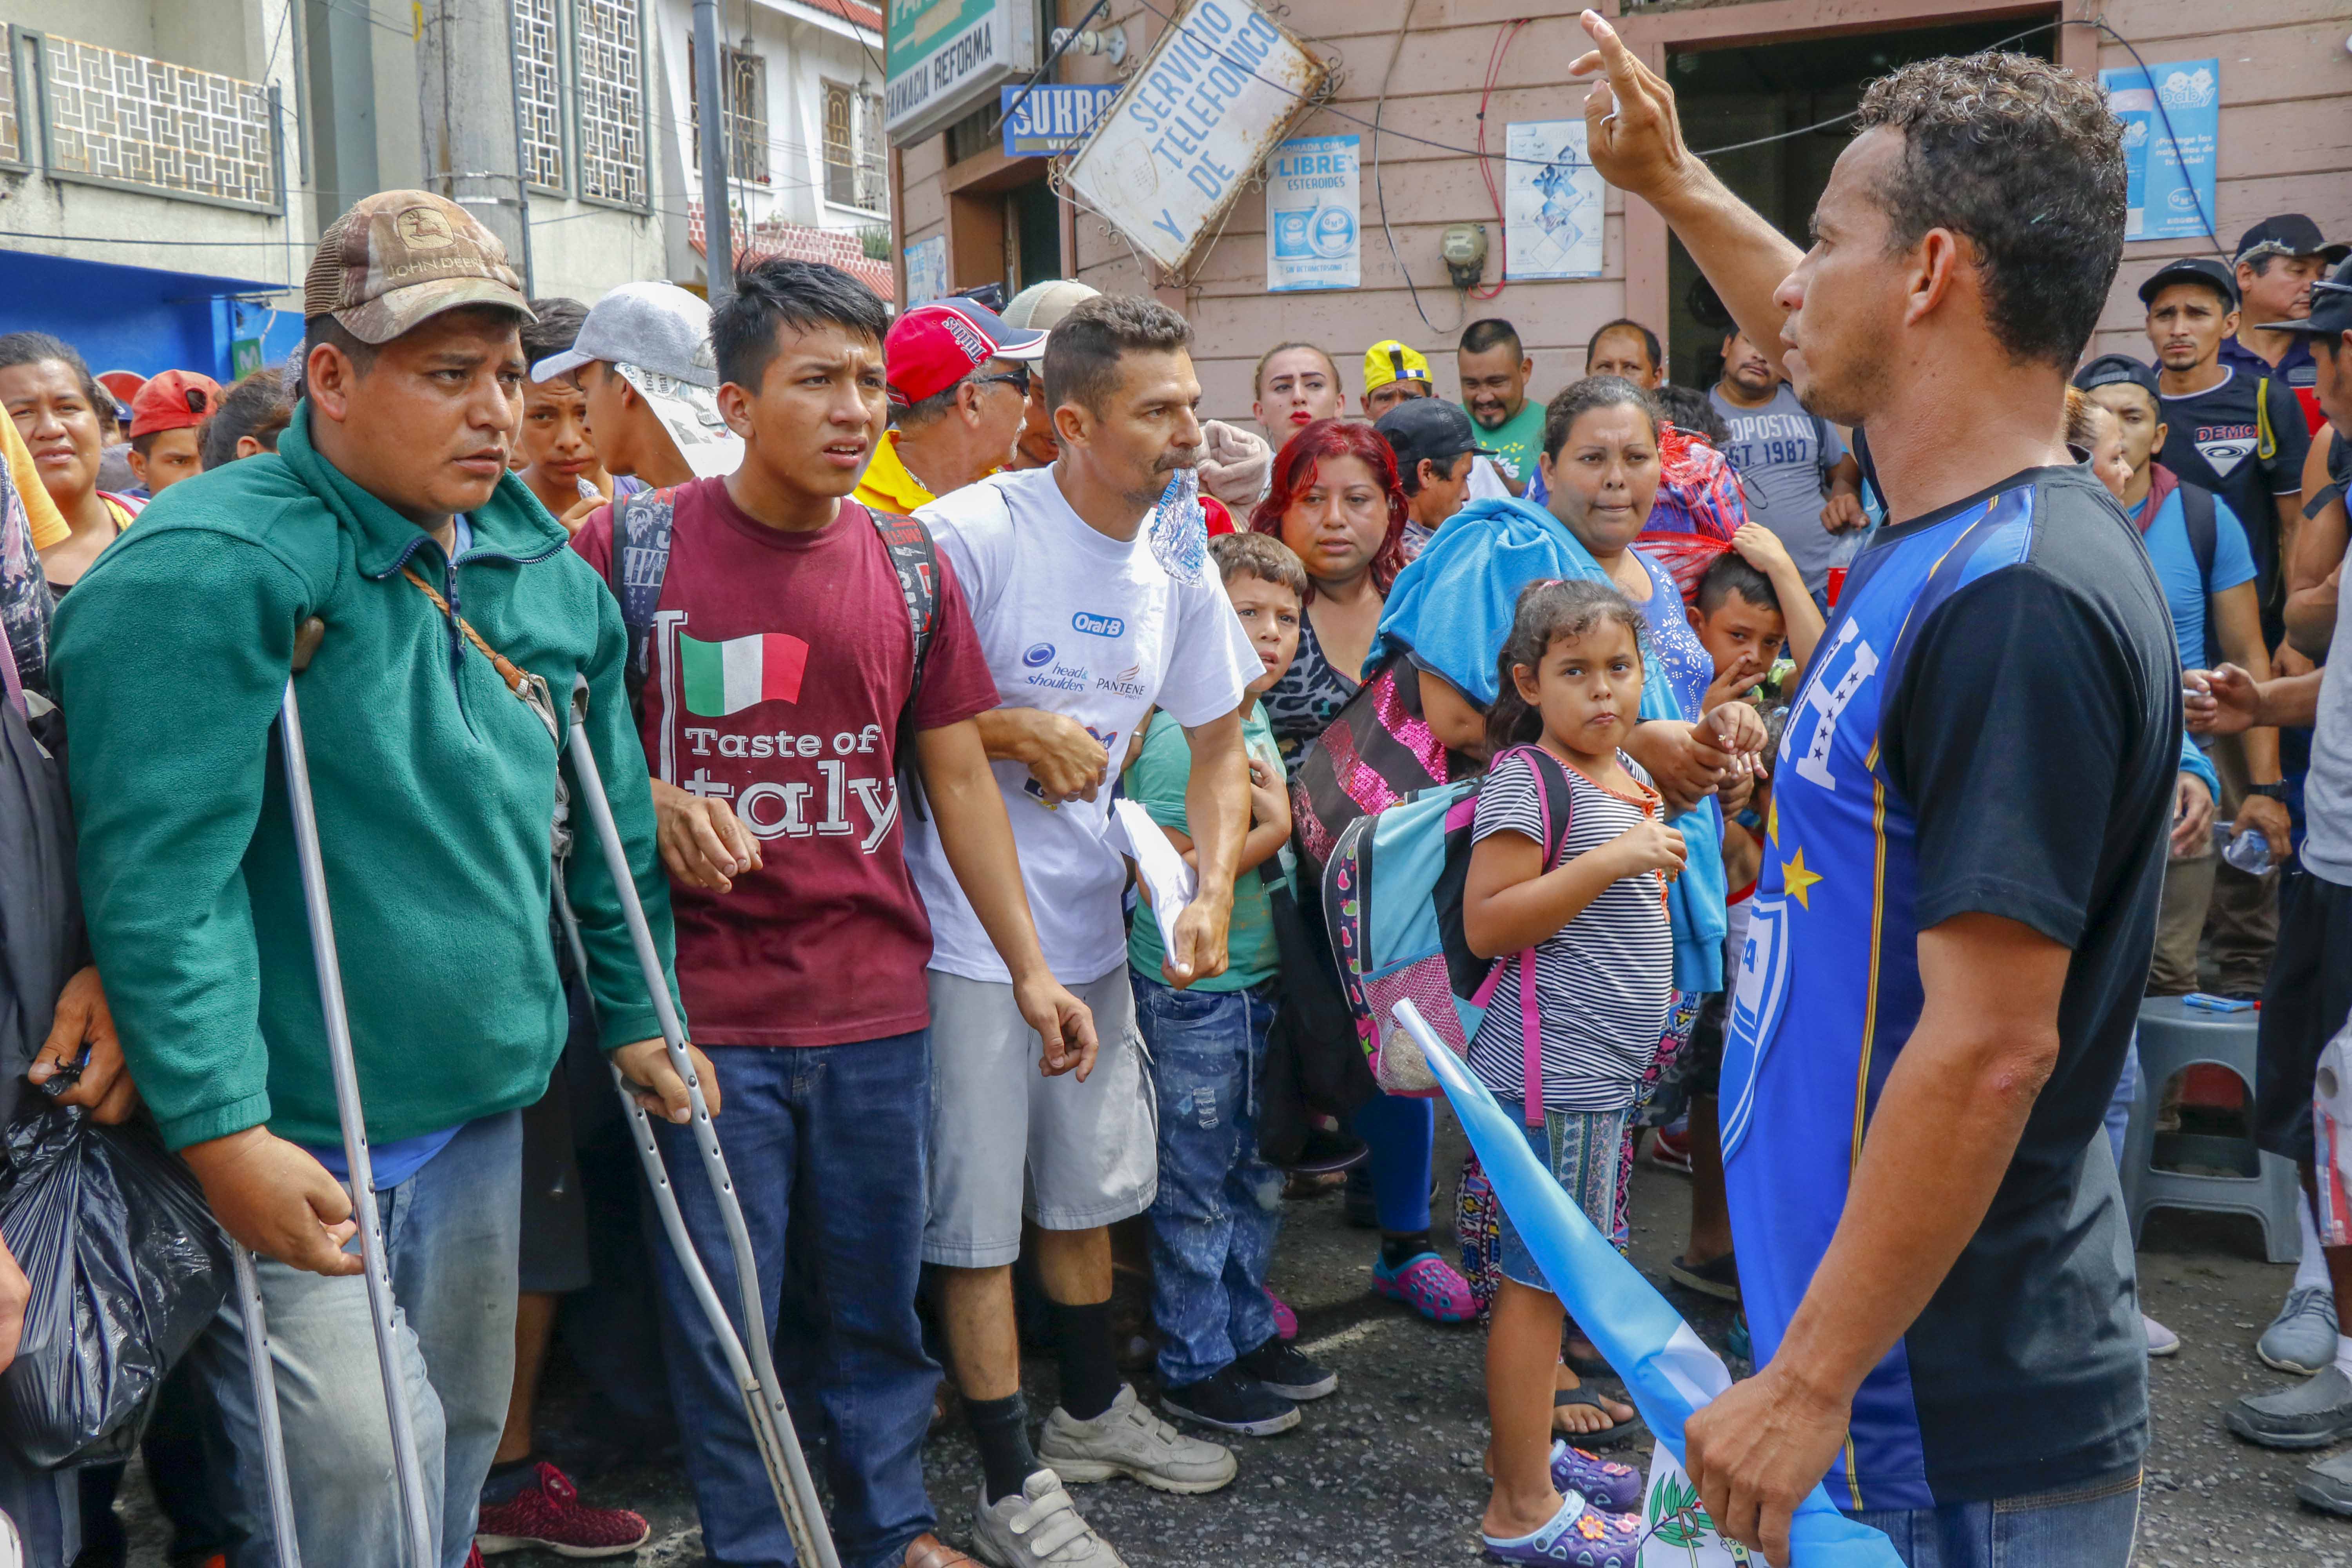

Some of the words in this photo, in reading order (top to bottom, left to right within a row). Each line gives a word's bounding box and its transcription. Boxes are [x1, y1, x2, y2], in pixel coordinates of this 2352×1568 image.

[886, 65, 928, 122] FARMACIA
[935, 22, 992, 91] REFORMA
[1129, 2, 1232, 133] SERVICIO
[1152, 12, 1279, 169] TELEFONICO
[1012, 89, 1126, 136] SUKRO
[1279, 143, 1321, 152] POMADA
[1279, 154, 1347, 176] LIBRE
[1152, 209, 1185, 243] Y
[1187, 150, 1235, 200] DE
[1288, 176, 1345, 191] ESTEROIDES
[387, 260, 439, 281] JOHN
[440, 257, 485, 269] DEERE
[941, 316, 987, 365] Twins
[1726, 414, 1818, 443] OPOSTAL
[1764, 439, 1806, 464] 1987
[1075, 614, 1122, 635] Oral-B
[1025, 673, 1085, 692] shoulders
[1096, 678, 1145, 695] PANTENE
[1786, 637, 1841, 738] HONDURAS
[684, 728, 822, 758] Taste
[833, 724, 881, 755] of
